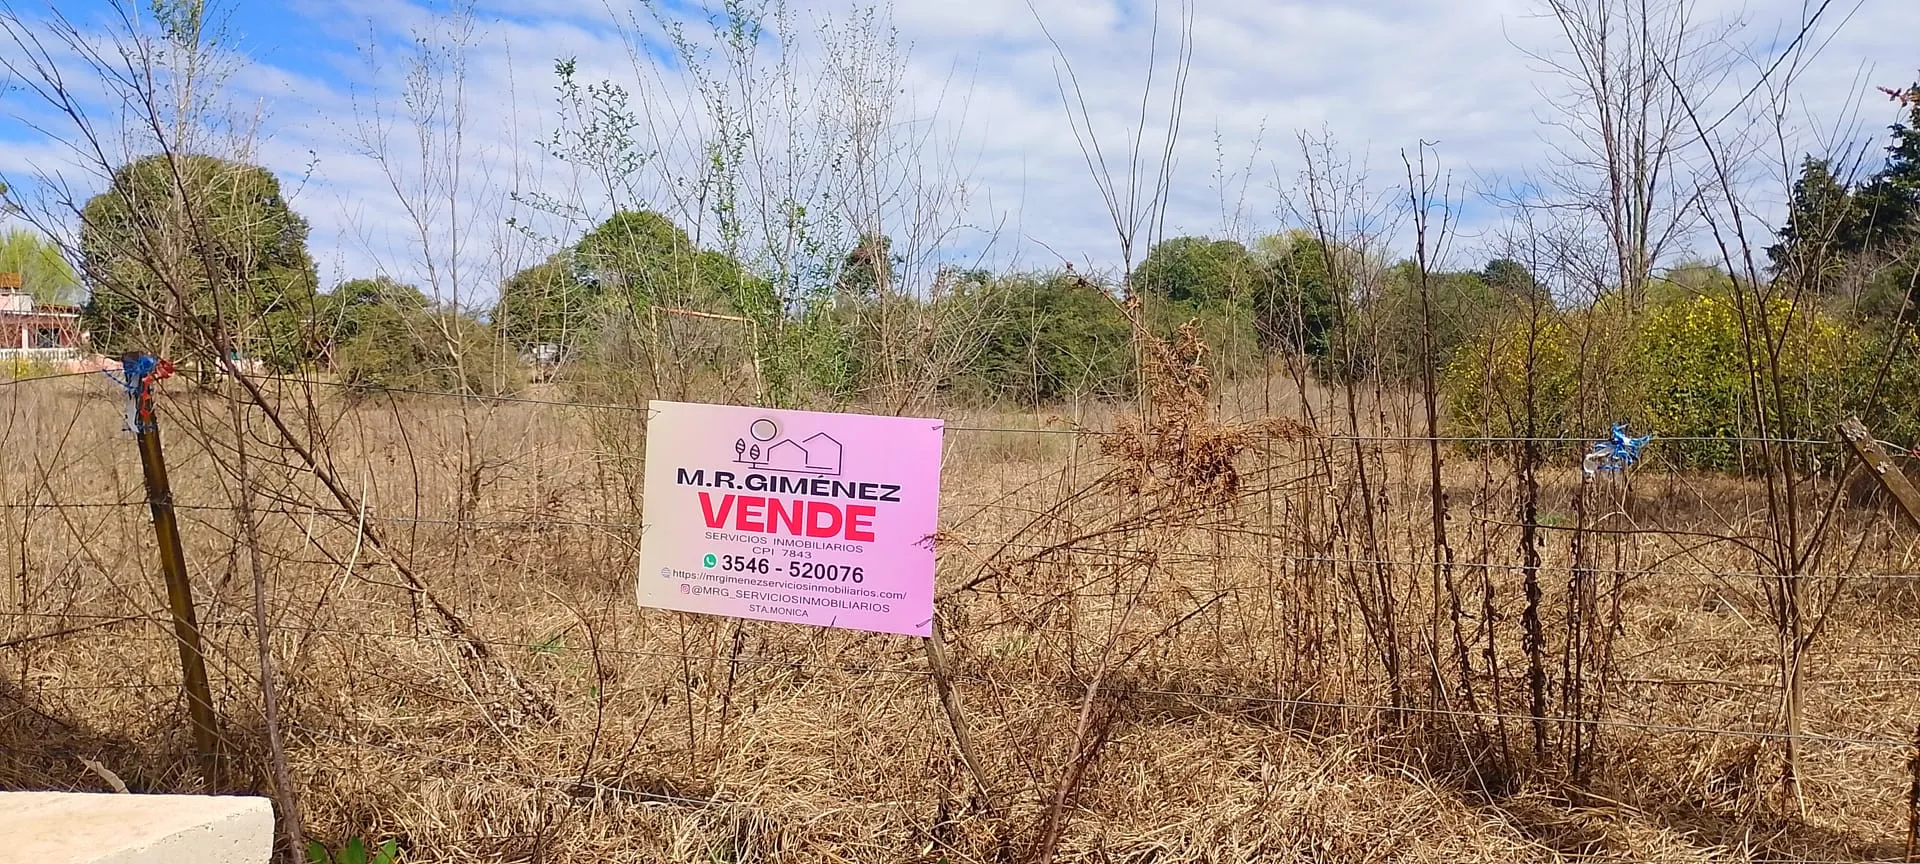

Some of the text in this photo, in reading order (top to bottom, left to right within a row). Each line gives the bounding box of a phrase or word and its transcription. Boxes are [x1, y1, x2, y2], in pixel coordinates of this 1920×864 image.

[677, 468, 901, 502] M.R.GIMÉNEZ
[698, 492, 877, 542] VENDE
[705, 531, 864, 553] SERVICIOS INMOBILIARIOS
[752, 546, 812, 559] CPI 7843
[722, 555, 769, 575] 3546
[789, 561, 864, 583] 520076
[672, 569, 907, 599] https://mrgimenezserviciosinmobiliarios.com/
[691, 585, 890, 613] @MRG_SERVICIOSINMOBILIARIOS
[749, 604, 809, 617] STA.MONICA
